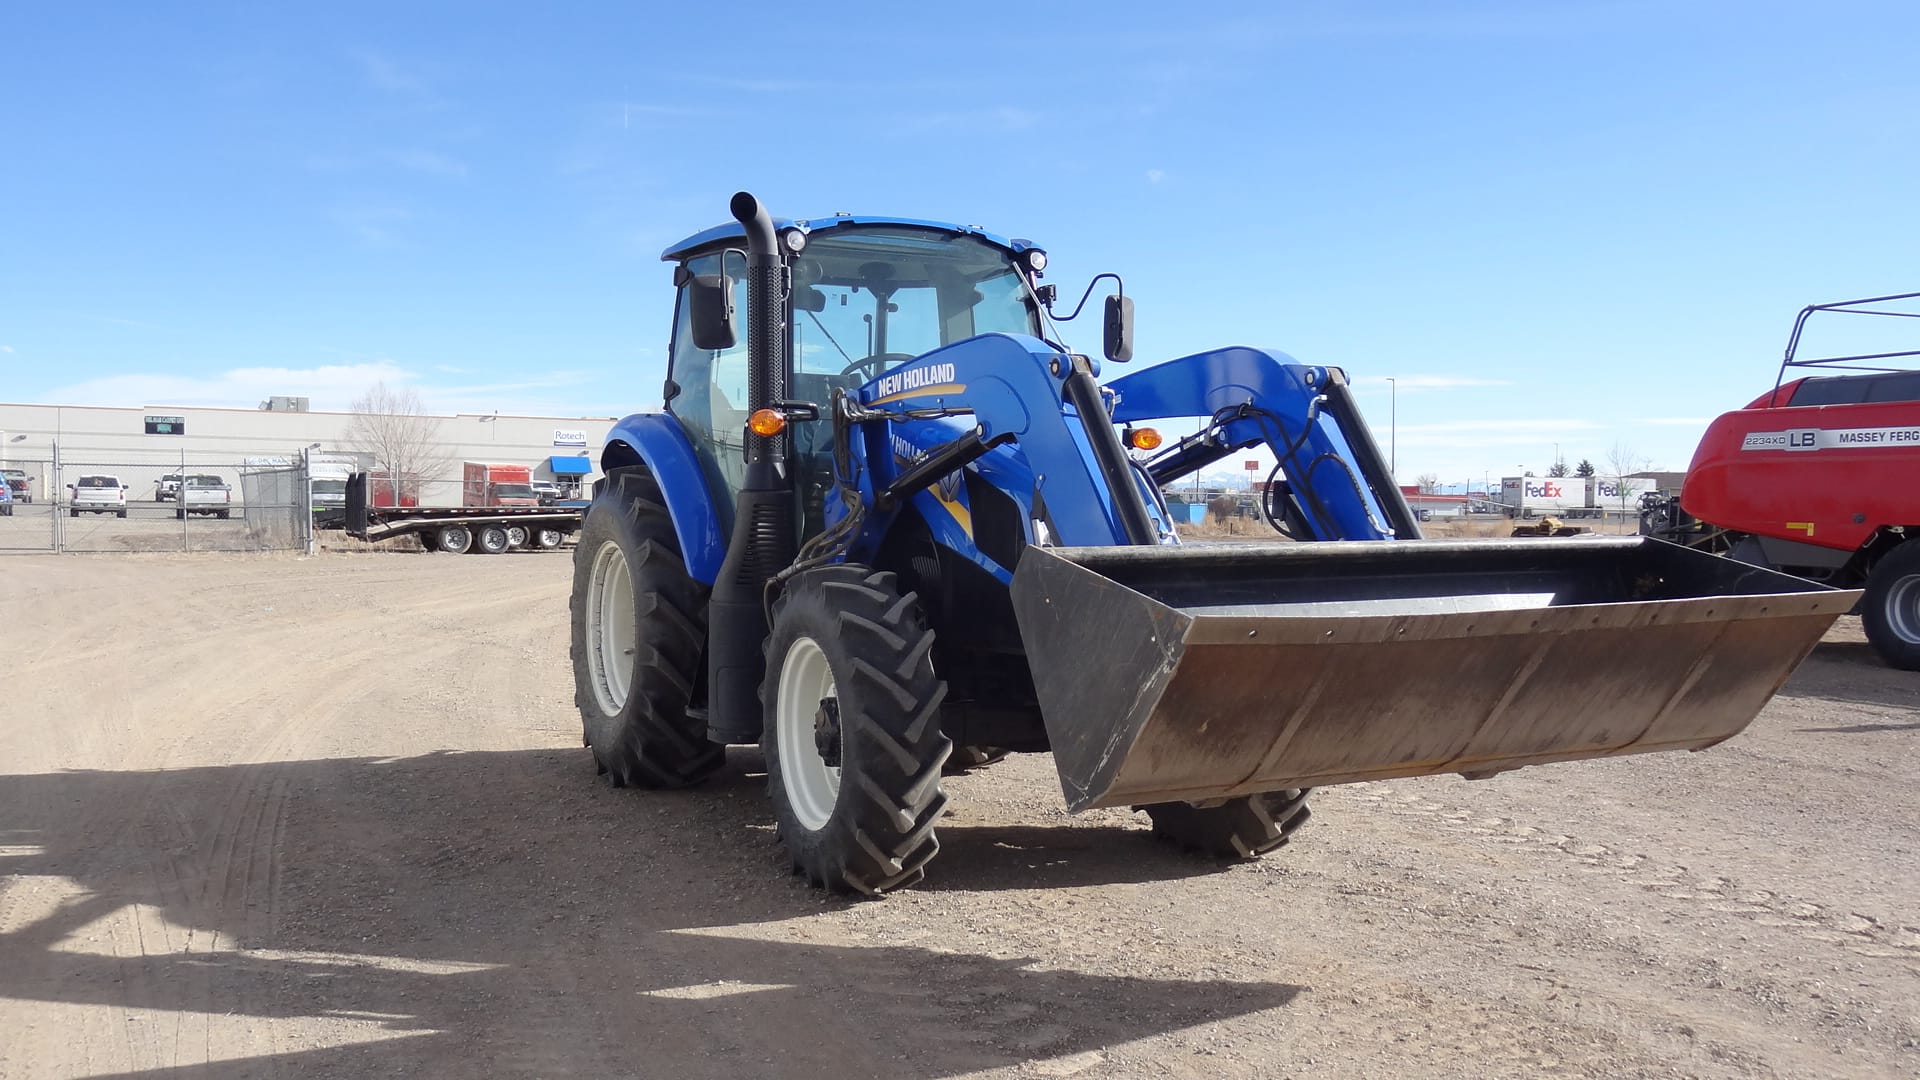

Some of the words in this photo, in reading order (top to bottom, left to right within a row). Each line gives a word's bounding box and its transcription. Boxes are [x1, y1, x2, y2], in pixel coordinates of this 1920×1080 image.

[878, 373, 902, 398] NEW
[903, 363, 955, 390] HOLLAND
[555, 431, 585, 440] Rotech
[1789, 432, 1815, 447] LB
[1839, 431, 1886, 443] MASSEY
[1504, 481, 1520, 489] FedEx
[1525, 481, 1562, 497] FedEx
[1598, 481, 1635, 497] FedEx
